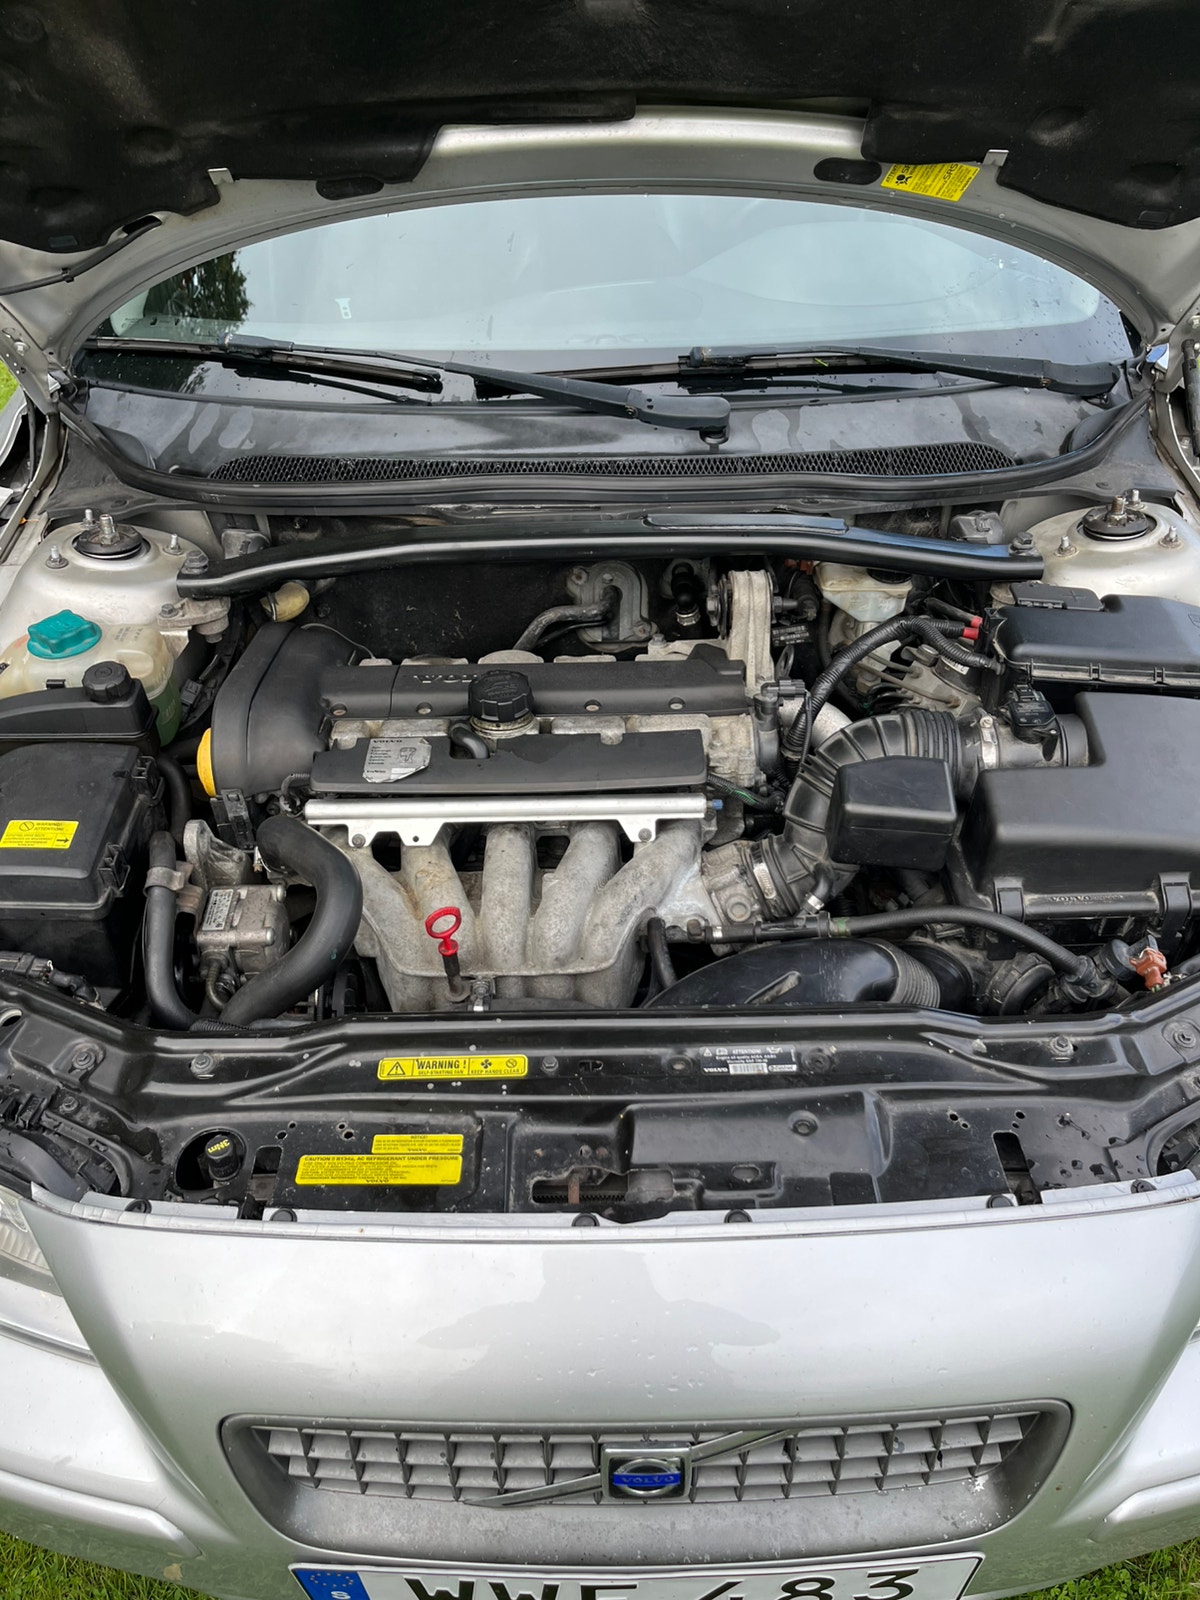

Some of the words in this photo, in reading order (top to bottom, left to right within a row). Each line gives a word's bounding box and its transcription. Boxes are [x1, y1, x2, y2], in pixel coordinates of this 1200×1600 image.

[943, 163, 959, 180] SRS
[413, 674, 479, 684] VOL
[416, 1059, 460, 1069] WARNING
[330, 1590, 351, 1600] S
